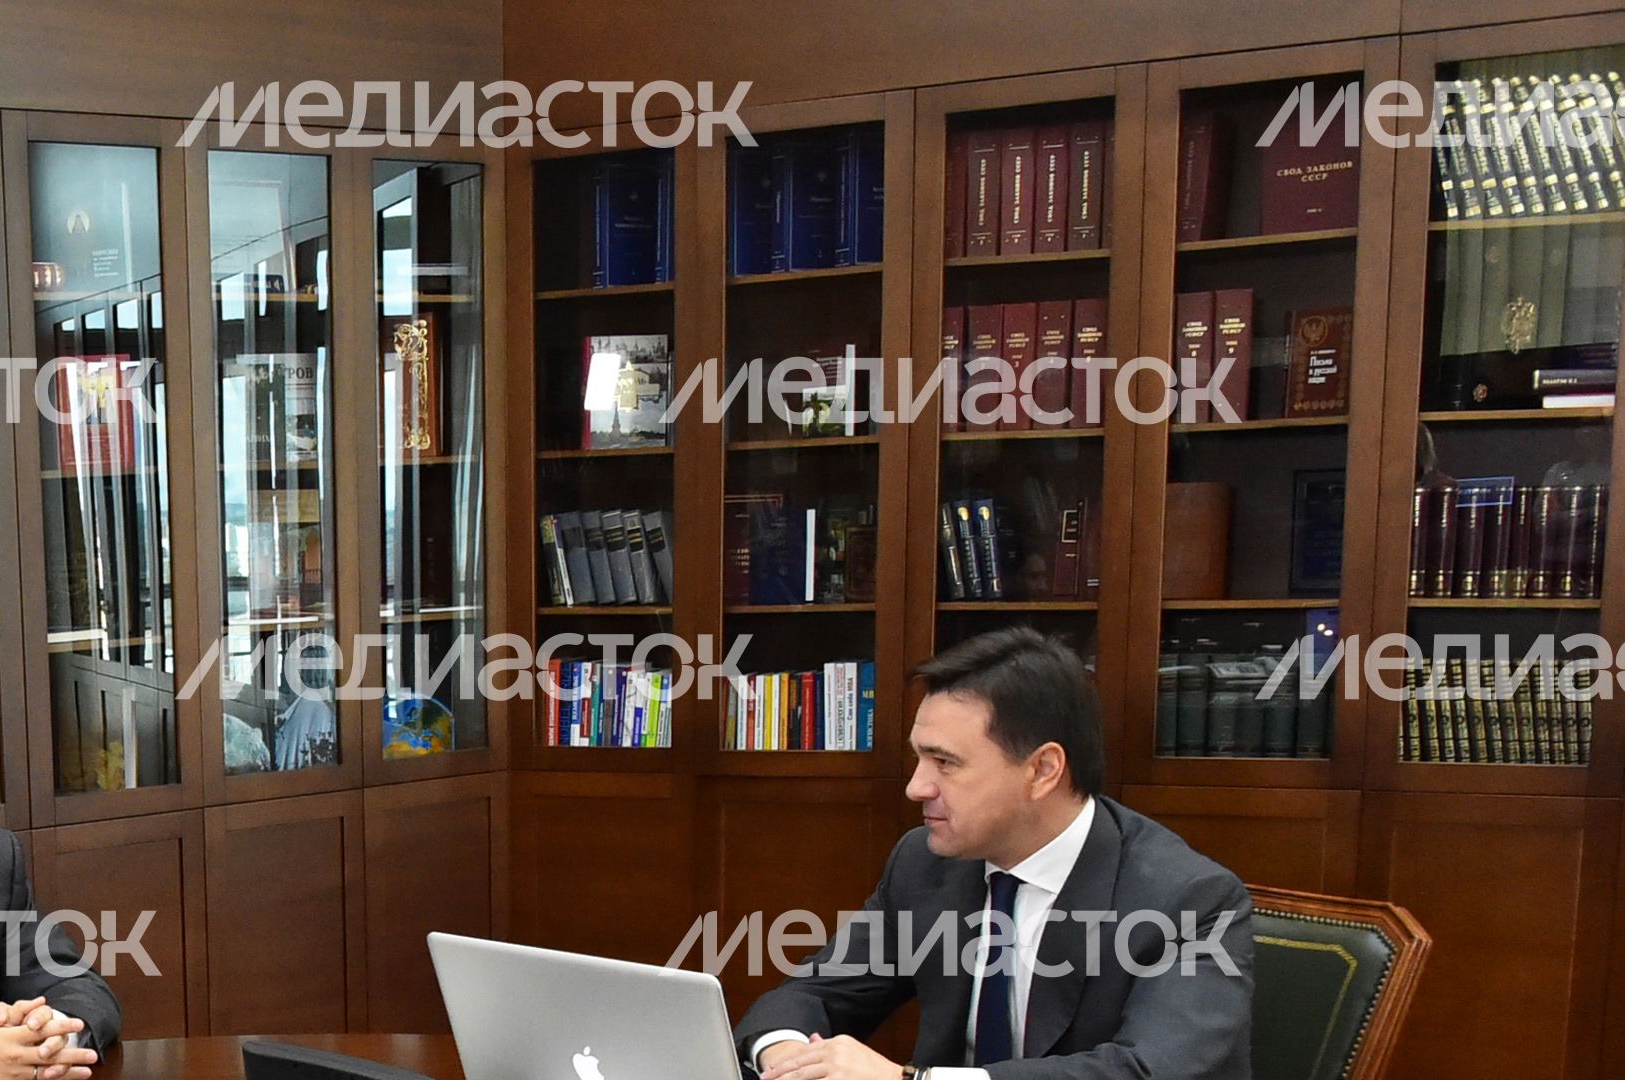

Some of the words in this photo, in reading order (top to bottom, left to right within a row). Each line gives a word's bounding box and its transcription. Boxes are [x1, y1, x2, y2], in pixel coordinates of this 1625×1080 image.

[1276, 167, 1303, 177] СВОД
[1306, 161, 1353, 173] ЗАКОНОВ
[1301, 173, 1328, 183] СССР
